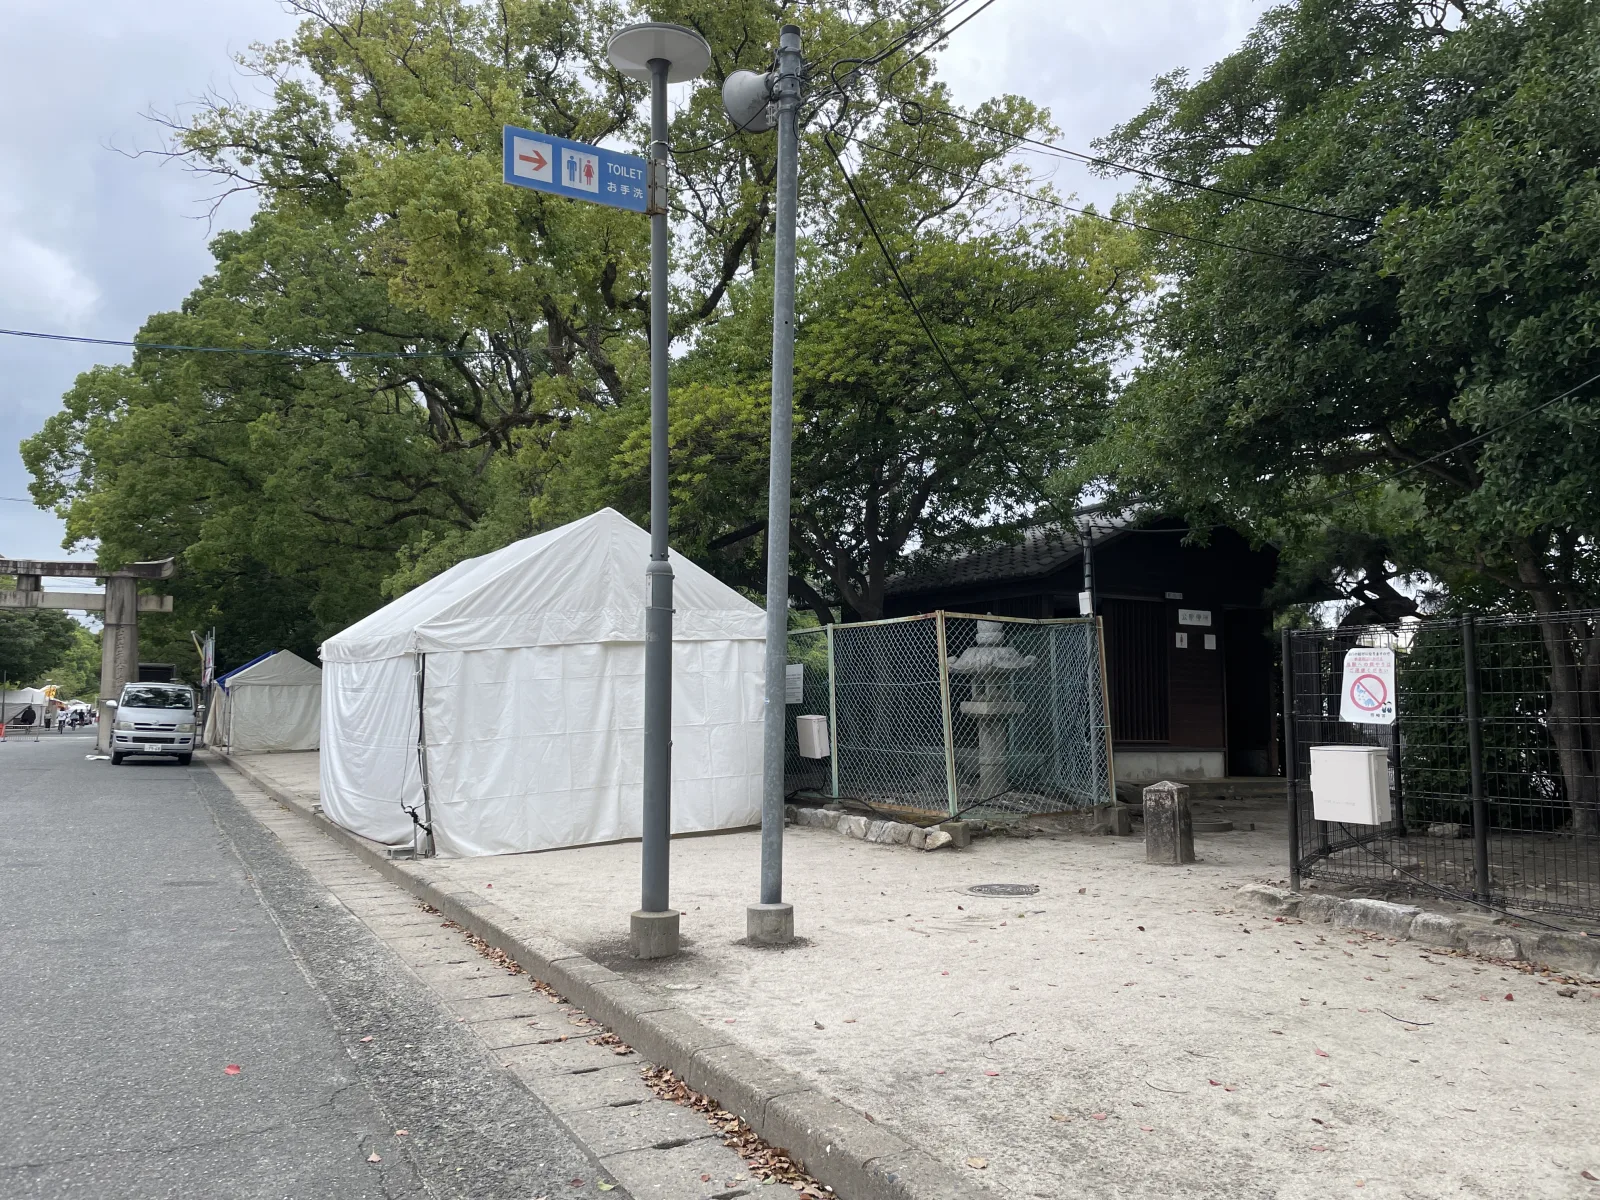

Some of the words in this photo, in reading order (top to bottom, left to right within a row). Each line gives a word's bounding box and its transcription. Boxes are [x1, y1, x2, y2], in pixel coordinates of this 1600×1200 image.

[606, 162, 643, 180] TOILET
[607, 182, 644, 199] お手洗
